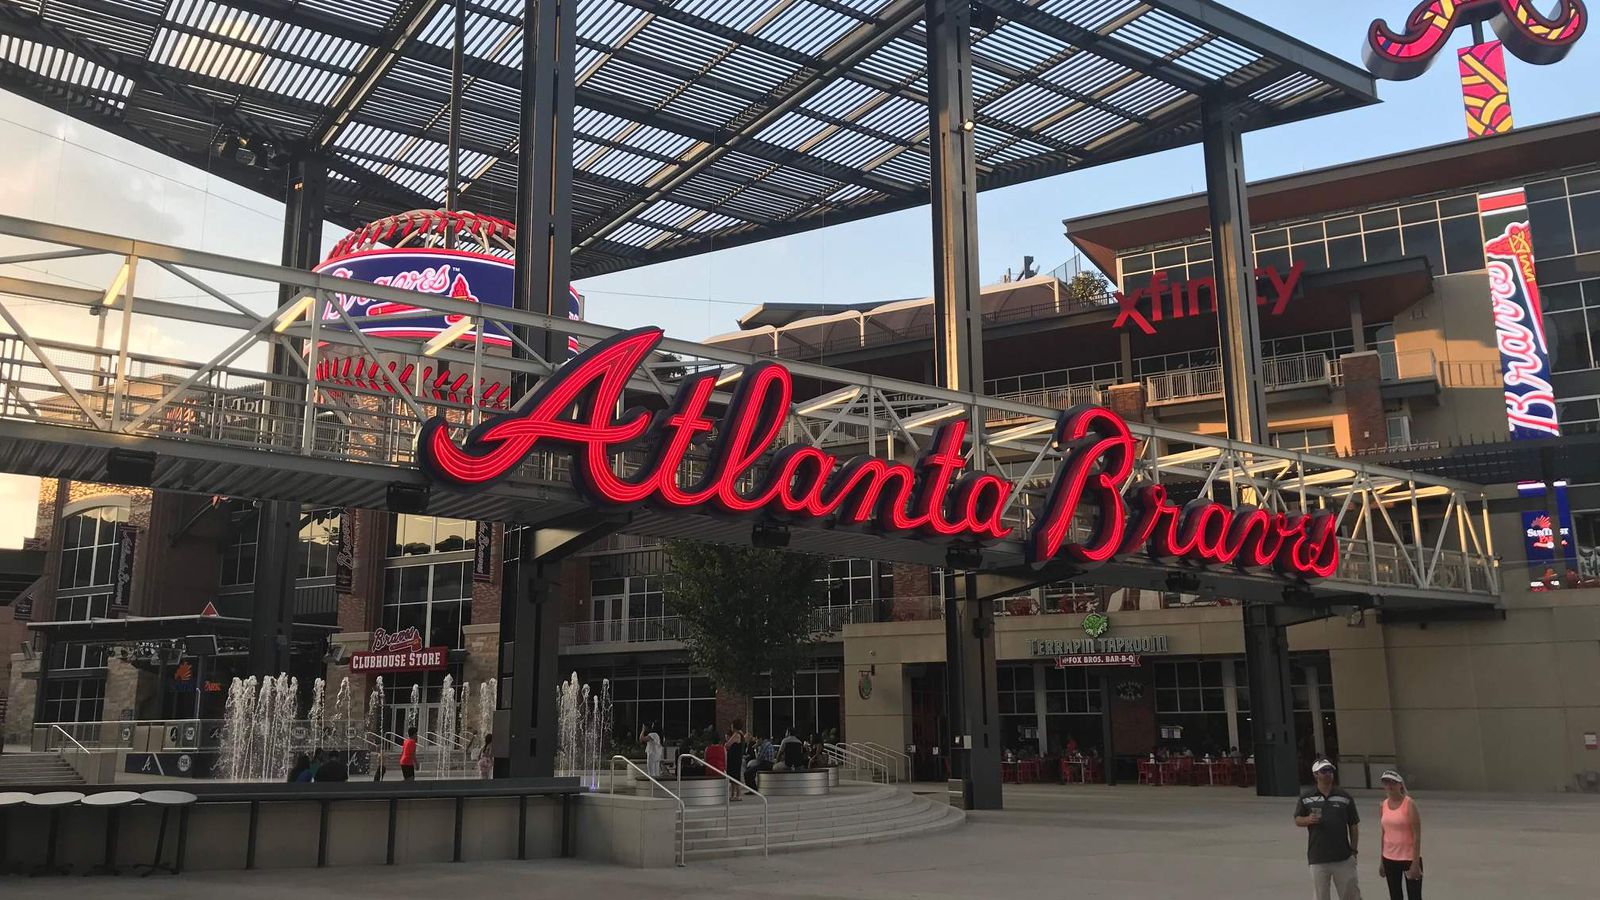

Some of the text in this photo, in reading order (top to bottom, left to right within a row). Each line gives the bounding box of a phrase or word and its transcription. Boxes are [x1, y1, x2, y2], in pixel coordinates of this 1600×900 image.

[1488, 260, 1560, 437] Braves
[424, 327, 1339, 578] Atlanta Braves
[372, 626, 415, 653] Braves
[352, 652, 441, 669] CLUBHOUSE STORE
[1083, 656, 1104, 664] BROS.
